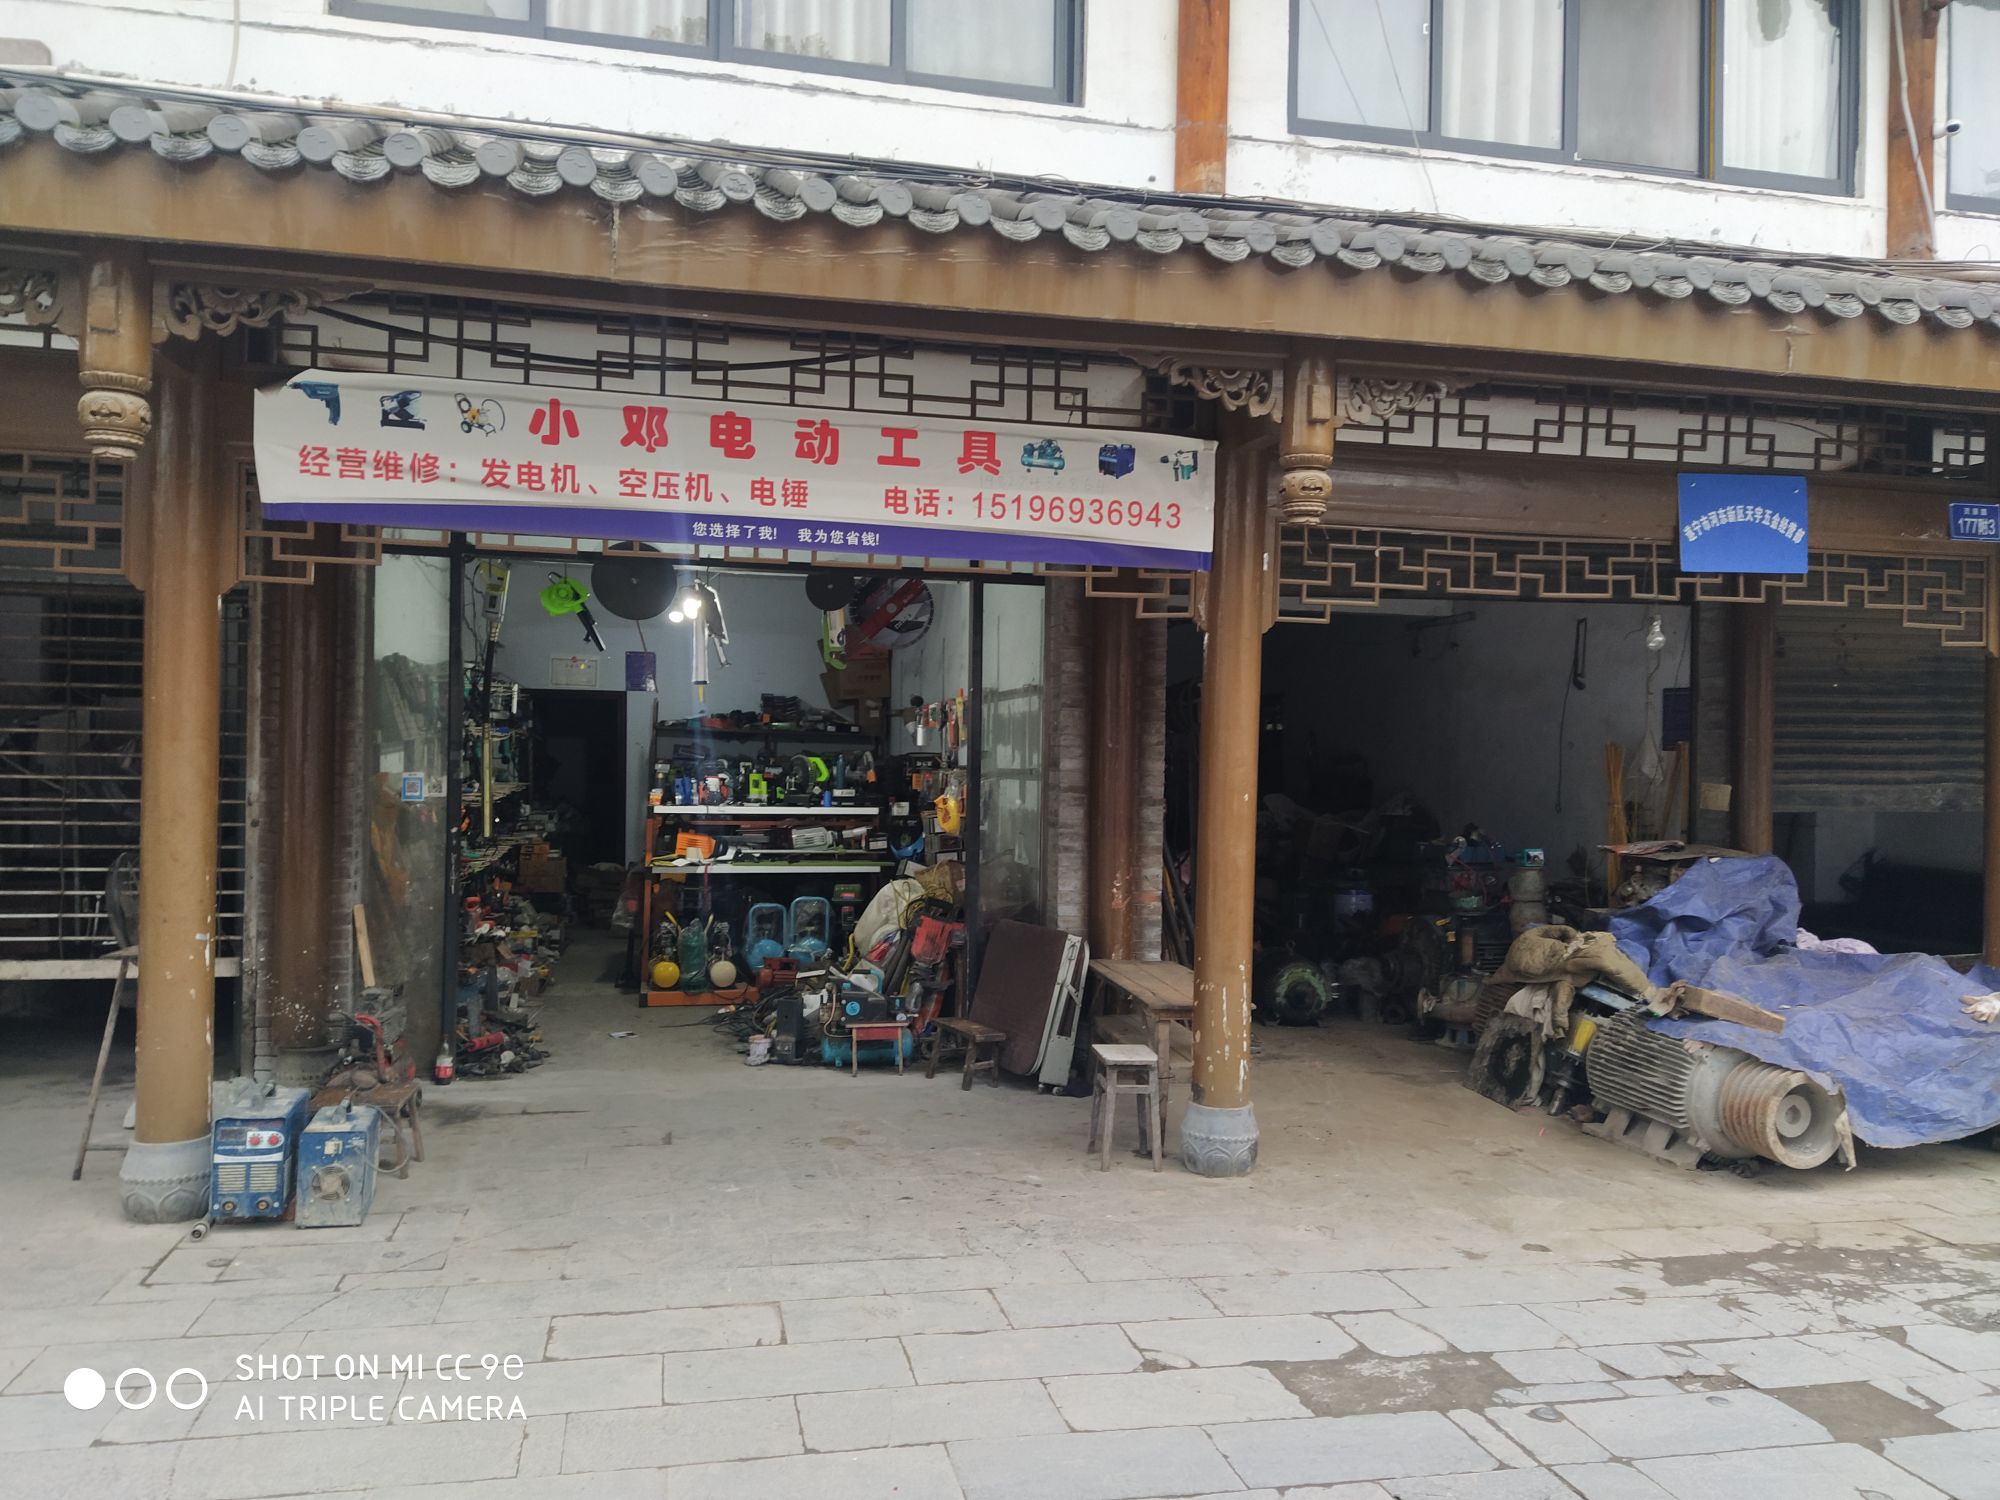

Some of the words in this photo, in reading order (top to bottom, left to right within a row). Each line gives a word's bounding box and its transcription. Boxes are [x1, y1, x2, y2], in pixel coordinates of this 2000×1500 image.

[529, 397, 1002, 476] 小邓电动工具
